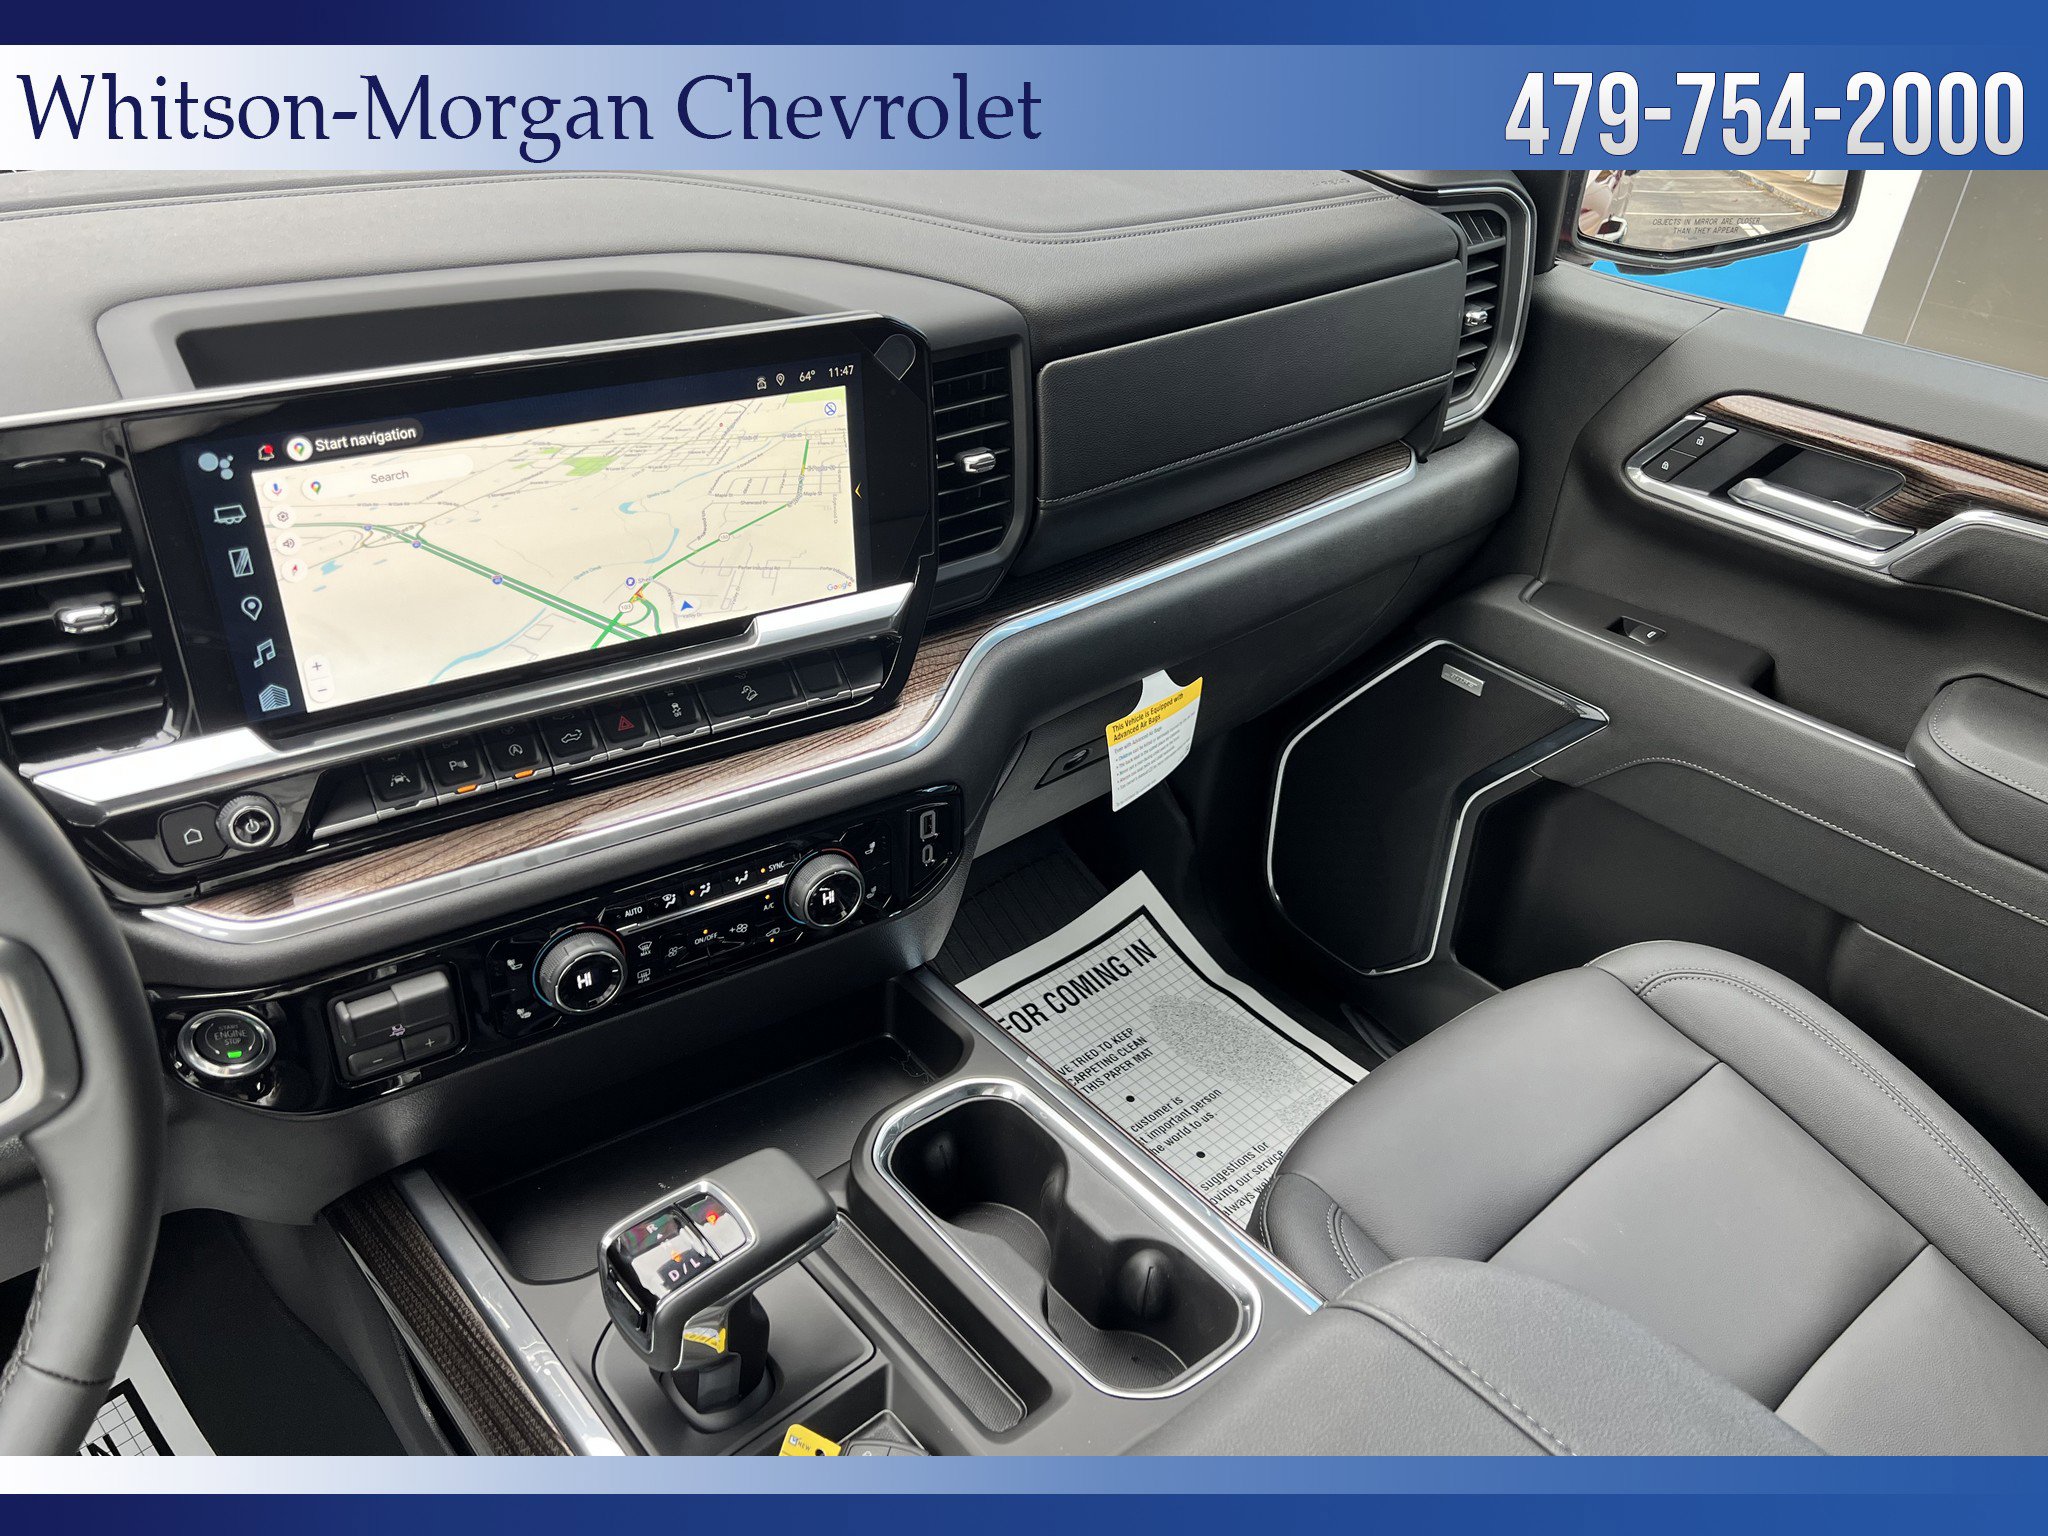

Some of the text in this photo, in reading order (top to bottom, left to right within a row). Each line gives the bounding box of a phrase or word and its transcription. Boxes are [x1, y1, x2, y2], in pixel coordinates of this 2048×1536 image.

[1652, 218, 1681, 226] OBJECTS
[1694, 217, 1718, 225] MIRROR
[1720, 217, 1733, 225] ARE
[1736, 217, 1761, 225] CLOSER
[1712, 226, 1739, 234] APPEAR
[828, 364, 854, 378] 11:47
[315, 426, 417, 453] Start navigation
[371, 468, 410, 485] Search
[826, 580, 853, 592] Google
[1112, 693, 1184, 733] This Vehicle is Equipped with
[1113, 714, 1161, 742] Advanced Air Bags
[768, 861, 785, 872] SYNC
[763, 902, 775, 911] A/C
[821, 889, 836, 907] HI
[624, 906, 643, 918] AUTO
[694, 932, 718, 945] ON/OFF
[576, 970, 593, 990] HI
[1043, 955, 1132, 1014] COMING
[1124, 938, 1158, 967] IN
[214, 1029, 248, 1040] ENGINE
[224, 1038, 241, 1046] STOP
[1070, 1048, 1100, 1069] TRIED
[1097, 1040, 1113, 1053] TO
[1110, 1027, 1134, 1045] KEEP
[1067, 1036, 1148, 1087] CARPETING CLEAN
[1079, 1047, 1154, 1095] THIS PAPER MAT
[1130, 1095, 1184, 1133] customer is
[1145, 1108, 1193, 1140] important
[1190, 1088, 1222, 1114] person
[1164, 1126, 1192, 1148] world
[1189, 1119, 1202, 1130] to
[1199, 1110, 1218, 1123] us.
[1200, 1141, 1270, 1192] suggestions for
[1236, 1172, 1253, 1187] our
[1251, 1149, 1284, 1175] service
[645, 1223, 658, 1234] R
